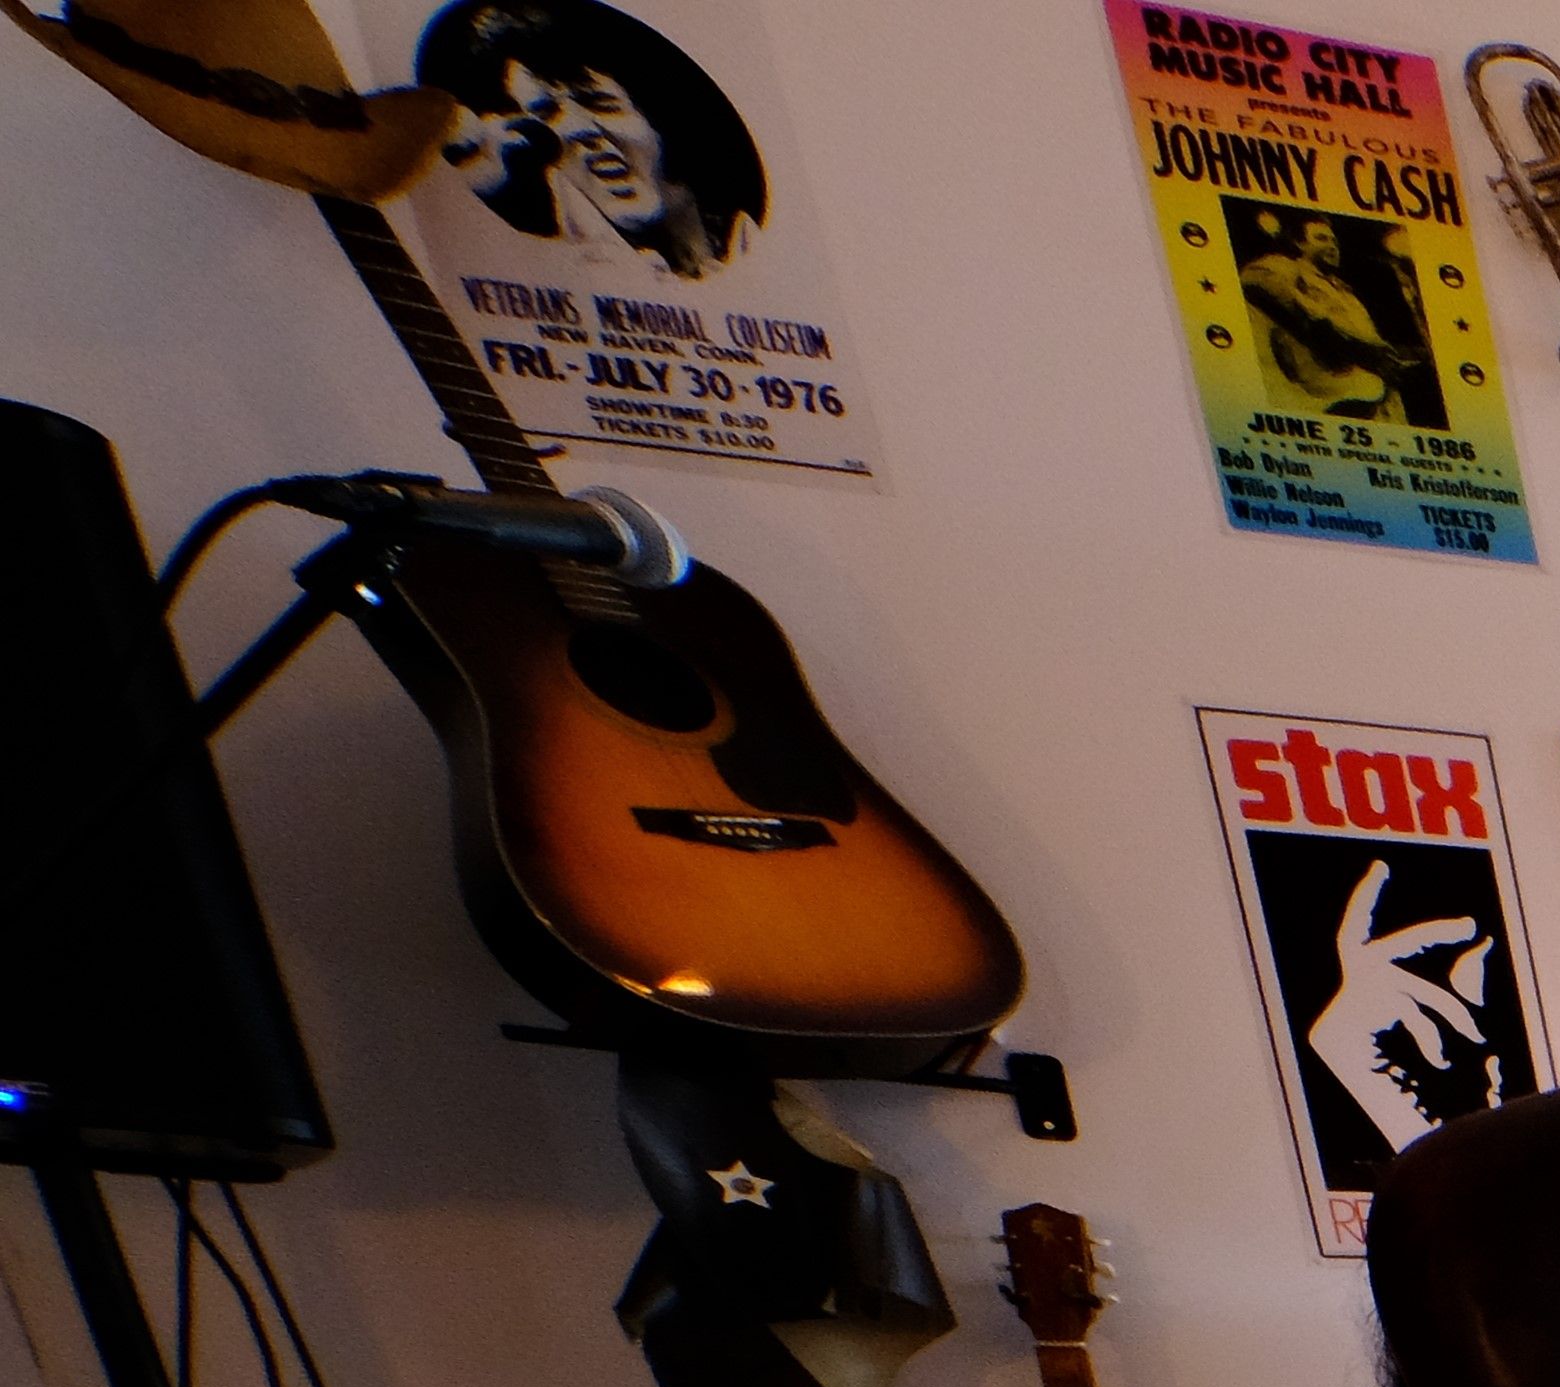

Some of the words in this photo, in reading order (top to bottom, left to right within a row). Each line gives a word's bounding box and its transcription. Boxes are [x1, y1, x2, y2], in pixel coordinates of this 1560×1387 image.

[1140, 7, 1289, 63] RADIO
[1309, 37, 1400, 84] CITY
[1147, 43, 1284, 96] MUSIC
[1303, 70, 1413, 119] HALL
[1144, 96, 1220, 127] THE
[1236, 113, 1442, 165] FABULOUS
[1152, 120, 1318, 203] JOHNNY
[1344, 154, 1464, 227] CASH
[461, 276, 583, 326] VETERANS
[593, 293, 712, 344] MEMORIAL
[726, 313, 832, 360] COLISEUM
[585, 396, 709, 427] SHOWTIME
[592, 415, 689, 442] TICKETS
[698, 429, 776, 452] $10.00
[1248, 412, 1328, 441] JUNE
[1339, 424, 1374, 448] 25
[1413, 435, 1476, 462] 1986
[1217, 447, 1255, 471] Bob
[1260, 452, 1313, 480] Dylan
[1367, 467, 1405, 491] Kris
[1419, 504, 1497, 534] TICKETS
[1227, 728, 1489, 840] stax
